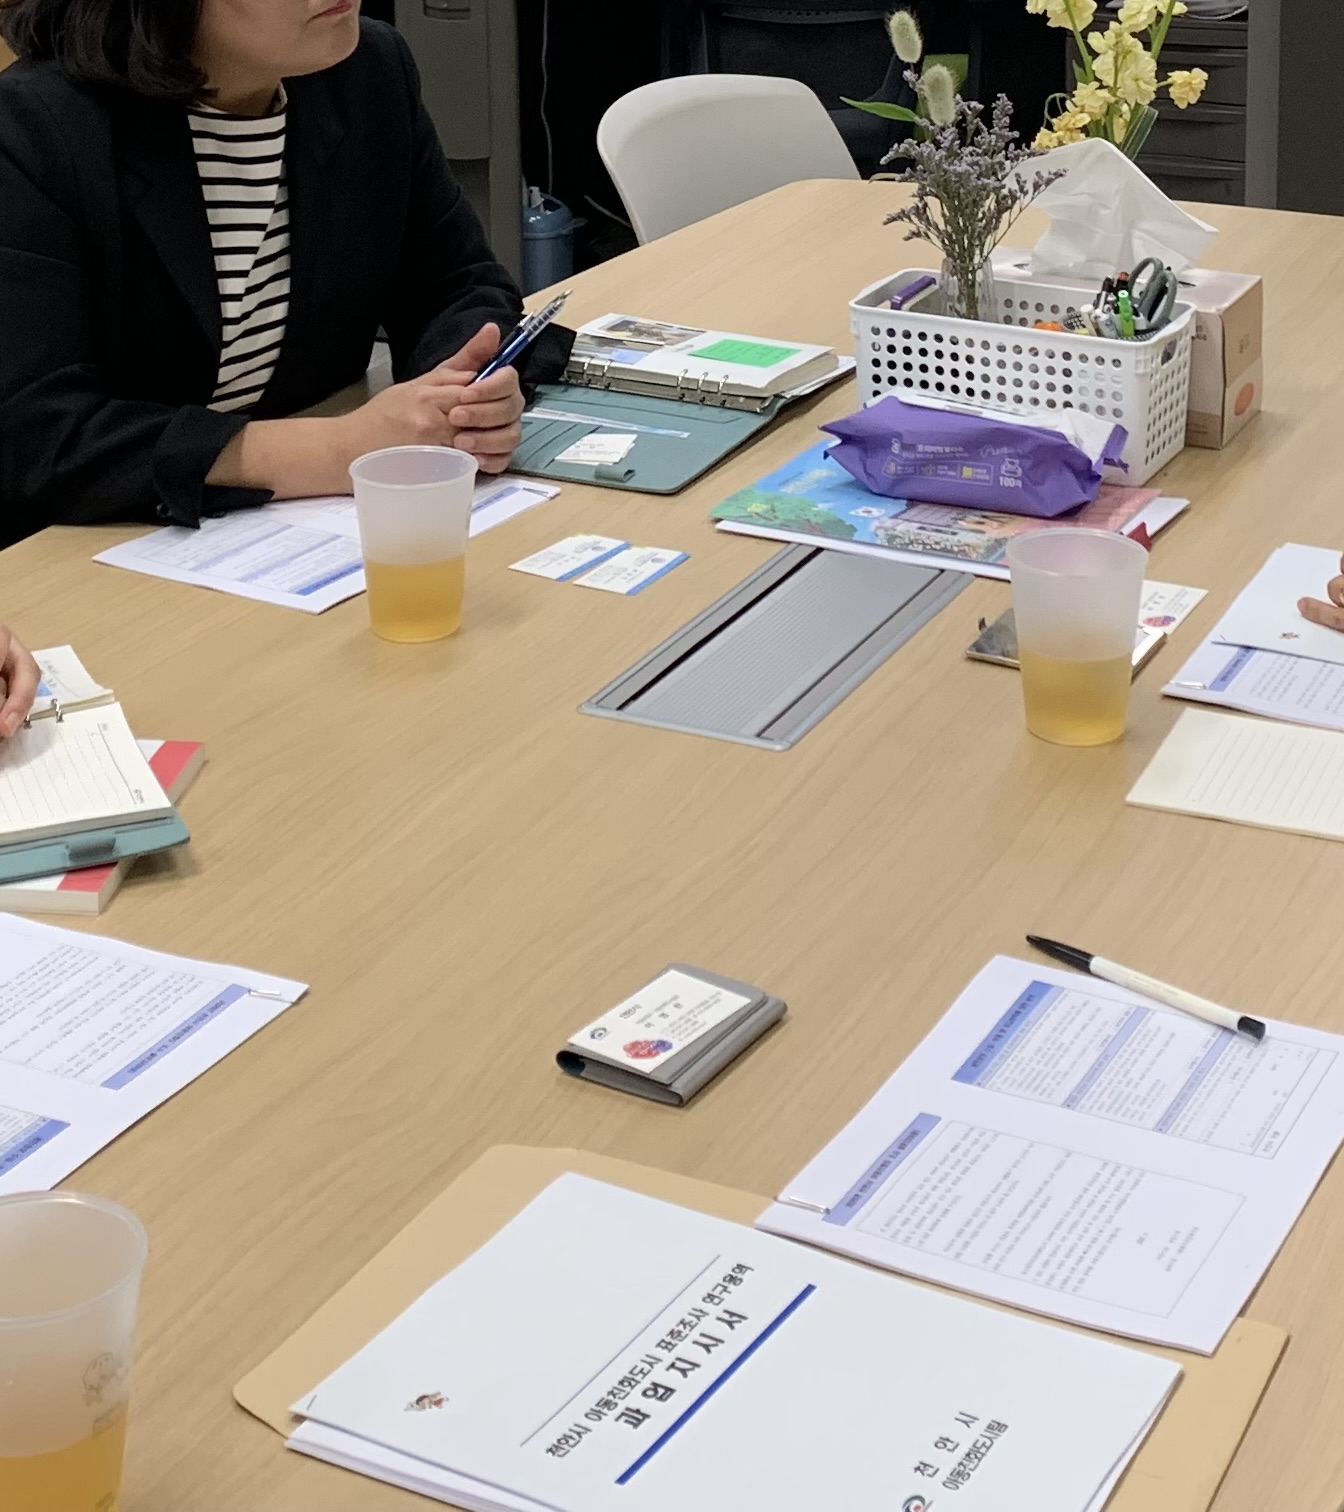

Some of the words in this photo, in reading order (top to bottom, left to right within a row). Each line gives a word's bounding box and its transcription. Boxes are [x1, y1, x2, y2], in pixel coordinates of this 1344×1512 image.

[545, 1423, 592, 1458] 천안시
[584, 1353, 663, 1423] 아동친화도시
[655, 1307, 710, 1354] 표준조사
[702, 1263, 755, 1306] 연구용역
[941, 1419, 1009, 1491] 아동친화도시팀
